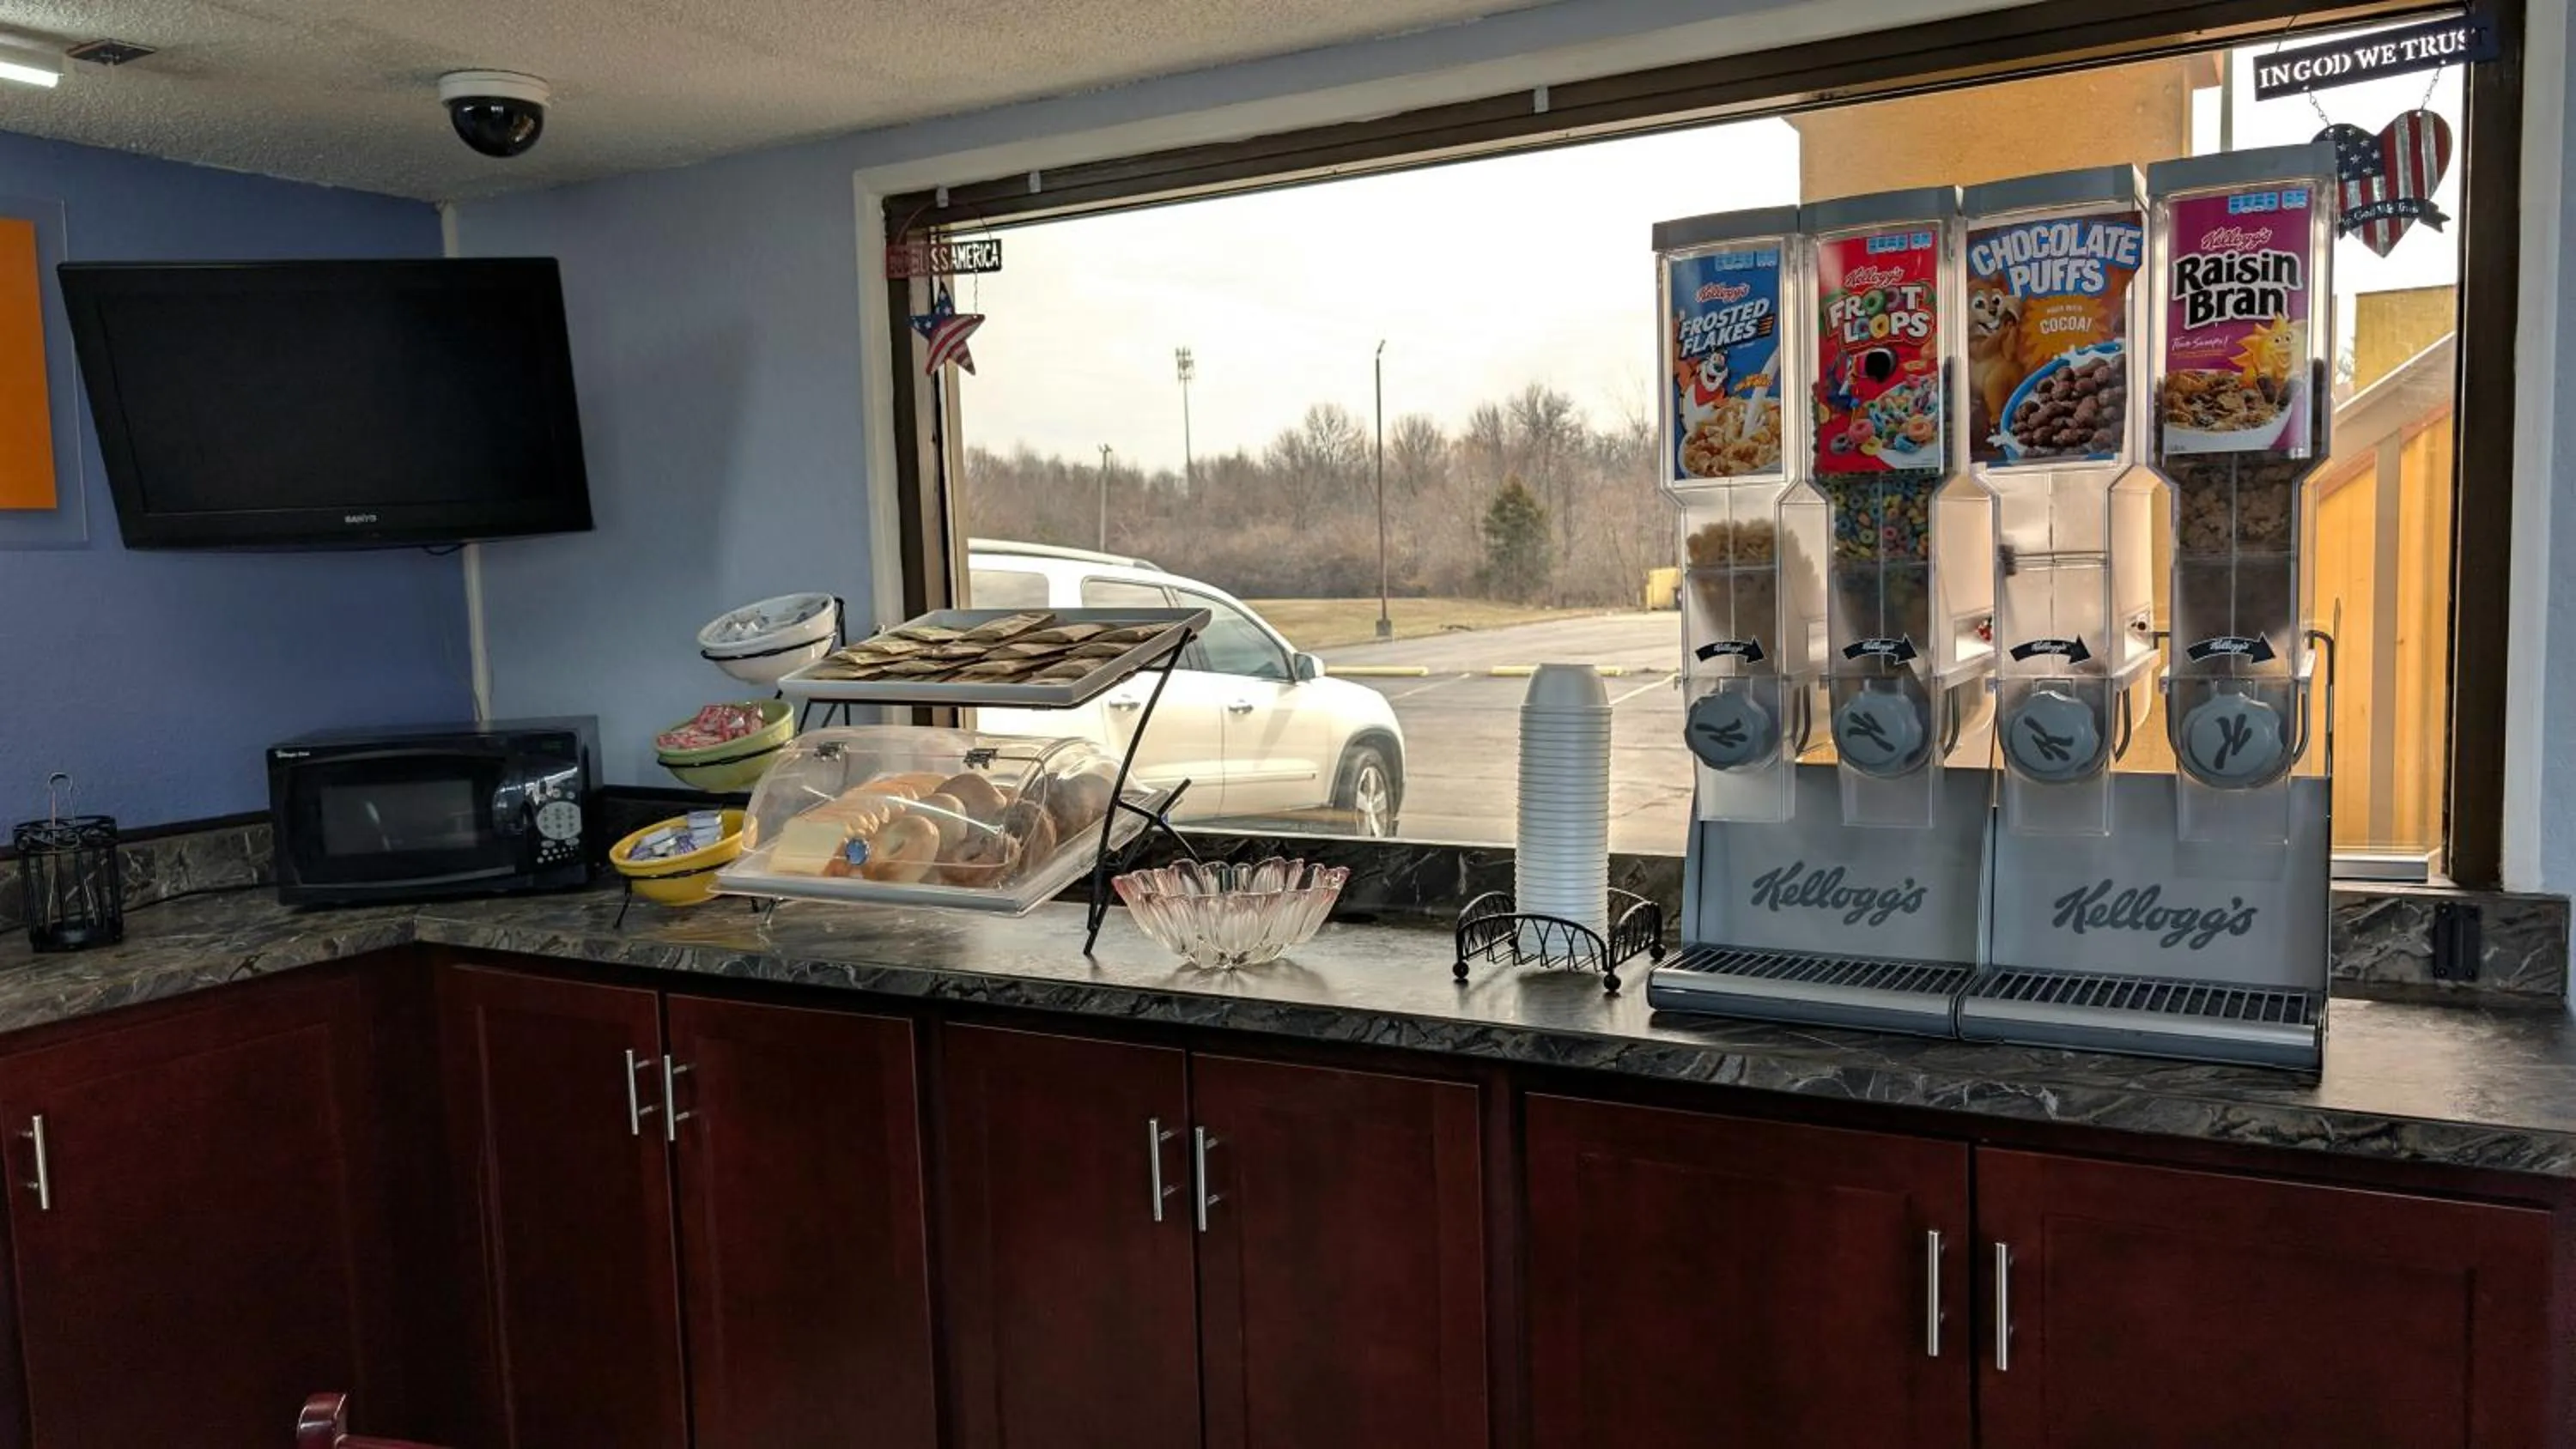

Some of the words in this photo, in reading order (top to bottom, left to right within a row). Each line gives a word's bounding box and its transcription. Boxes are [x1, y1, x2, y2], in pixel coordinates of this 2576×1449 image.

[2259, 63, 2292, 88] IN
[2293, 53, 2351, 81] GOD
[2354, 45, 2397, 70] WE
[951, 242, 999, 271] AMERICA
[1971, 222, 2142, 276] CHOCOLATE
[2201, 227, 2273, 251] Kellogg's
[1844, 265, 1905, 288] Kellogg's
[2009, 258, 2105, 298] PUFFS
[2173, 250, 2301, 298] Raisin
[1679, 297, 1771, 341] FROSTED
[1828, 286, 1923, 330] FROOT
[2039, 315, 2093, 336] COCOA!
[2187, 285, 2287, 327] Bran
[1680, 318, 1759, 359] FLAKES
[1843, 311, 1931, 344] LOOPS
[2031, 640, 2068, 654] Kellogg's
[2210, 639, 2248, 653] Kellogg's
[1751, 861, 1929, 926] Kellogg's
[2053, 878, 2259, 949] Kellogg's
